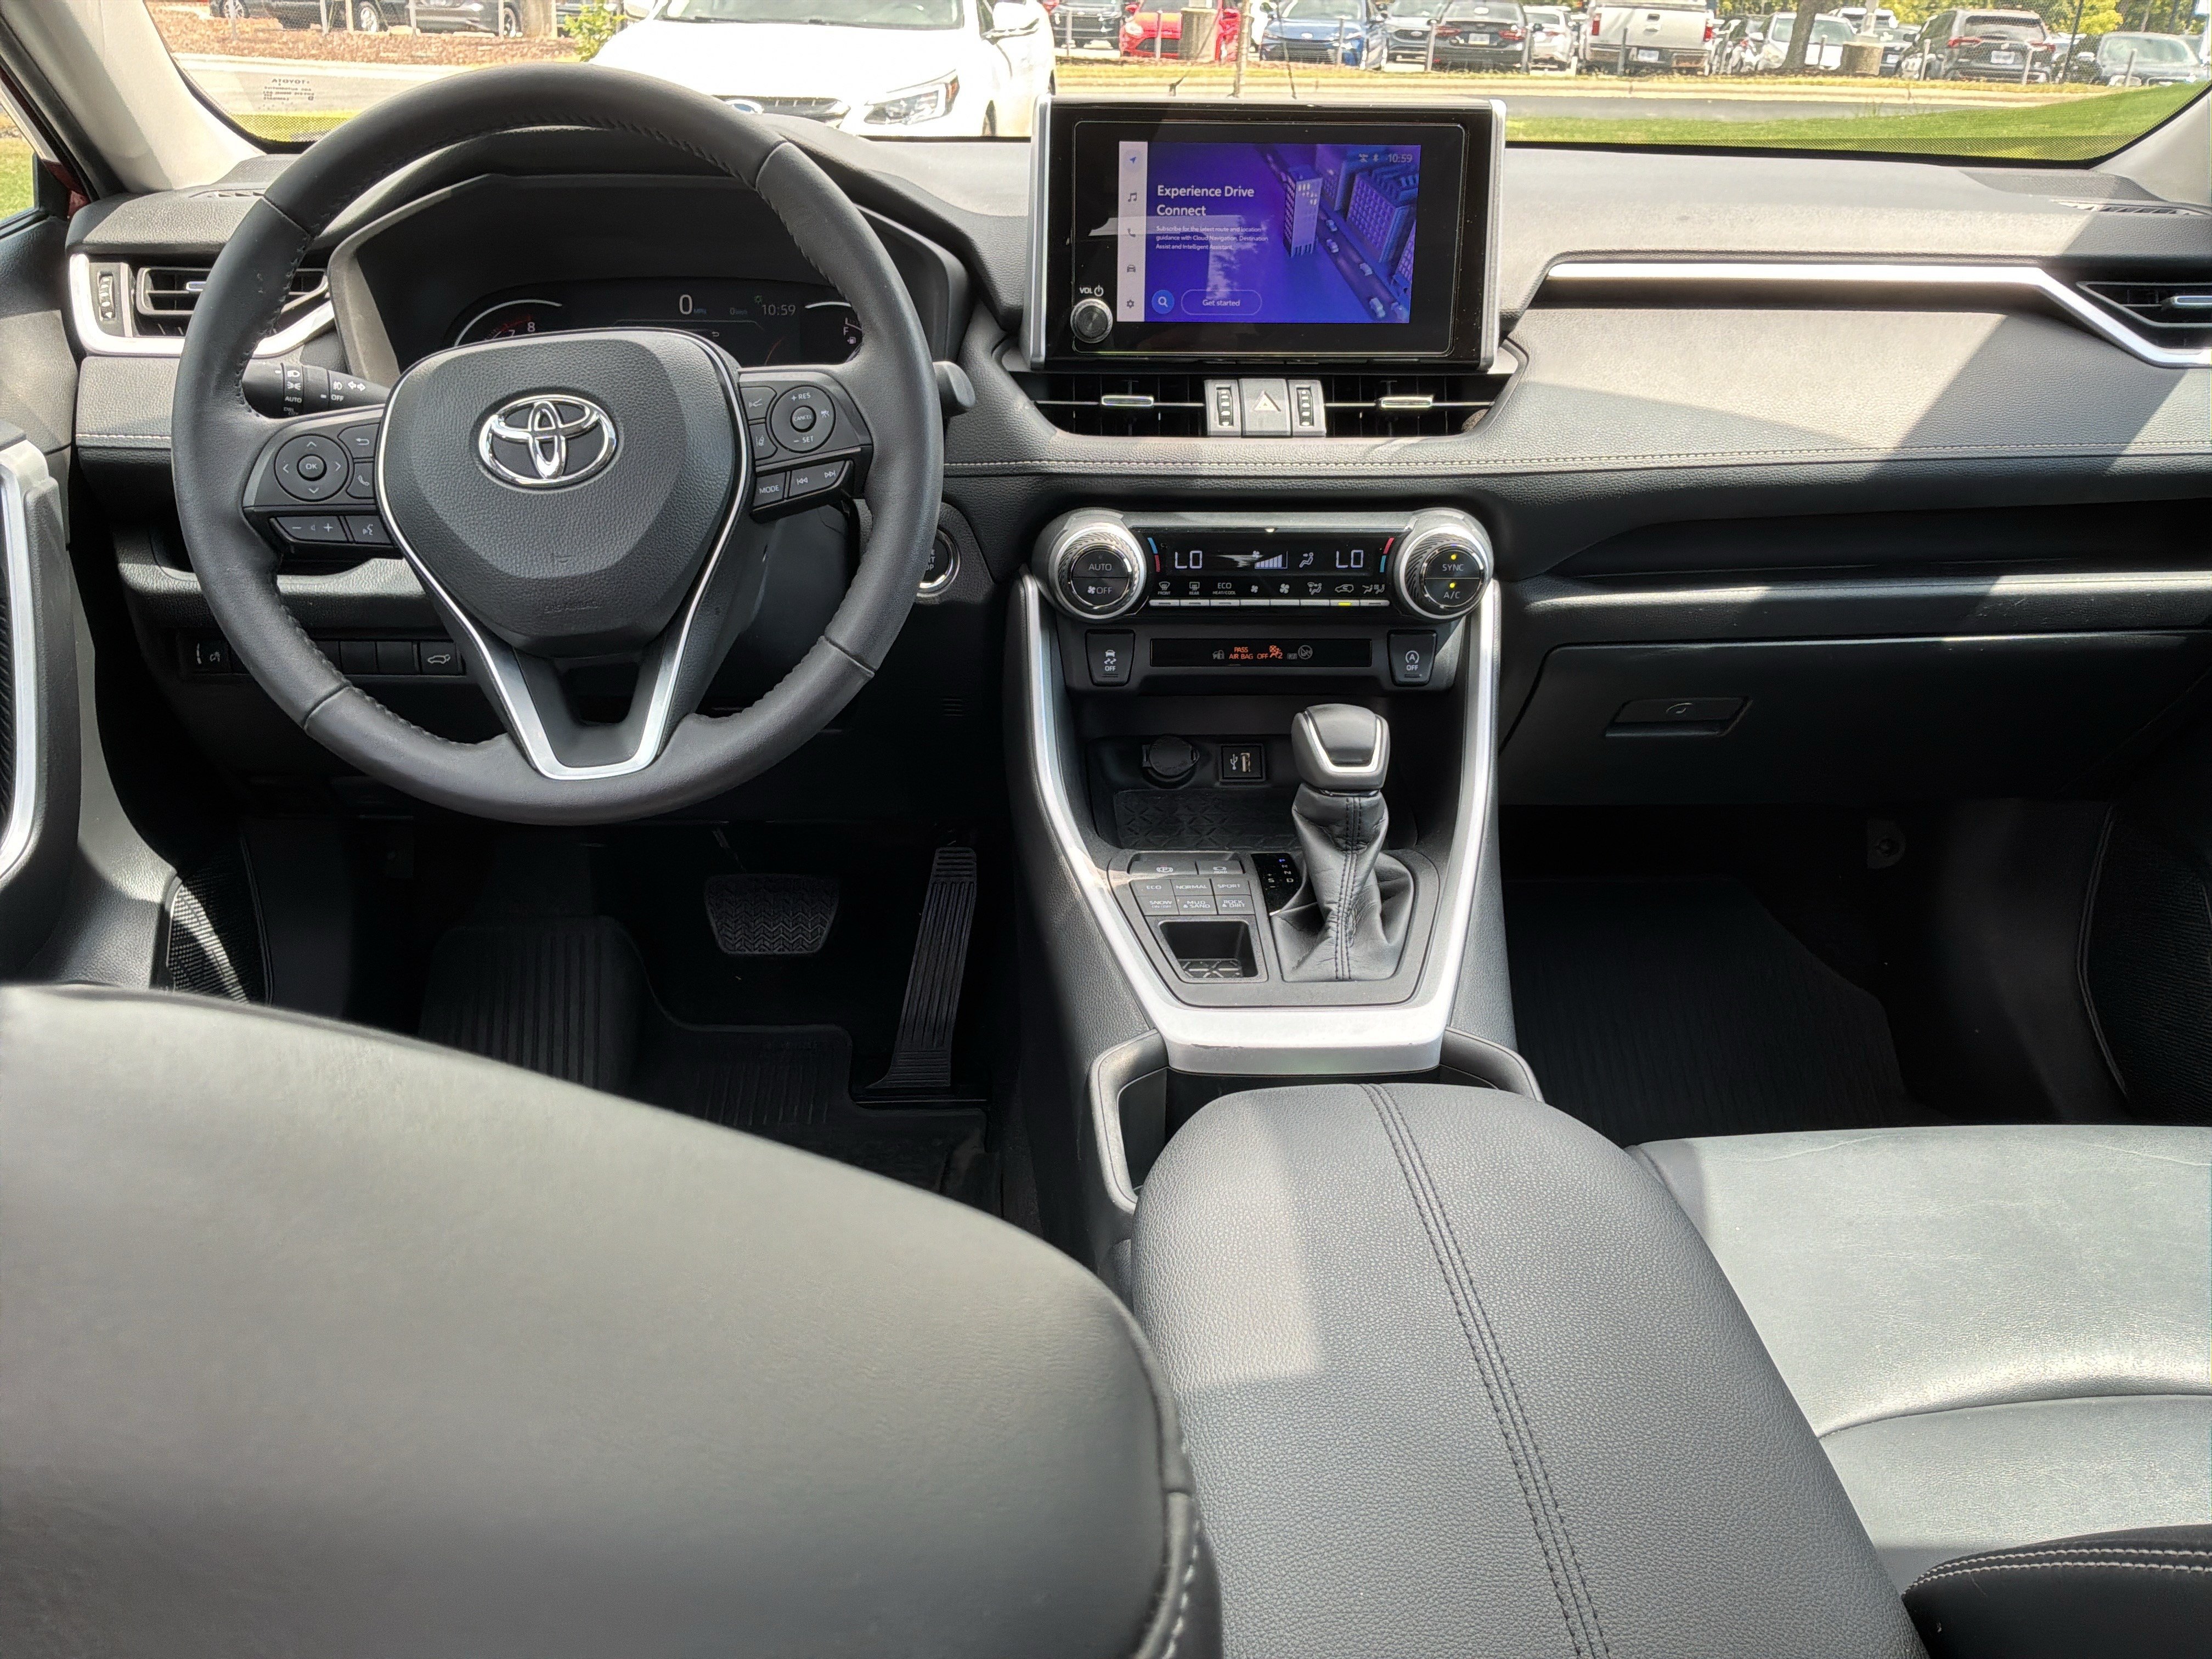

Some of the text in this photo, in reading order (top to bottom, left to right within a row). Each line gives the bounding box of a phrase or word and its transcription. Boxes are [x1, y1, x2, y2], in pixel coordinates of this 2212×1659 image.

[1388, 154, 1413, 163] 10:59
[1157, 185, 1255, 199] Experience Drive
[1156, 204, 1207, 216] Connect
[1079, 286, 1093, 295] VOL
[679, 294, 693, 315] 0
[761, 303, 796, 316] 10:59
[527, 321, 536, 332] 8
[843, 326, 849, 336] F
[284, 396, 302, 404] AUTO
[331, 394, 345, 402] OFF
[759, 484, 780, 494] MODE
[1175, 550, 1203, 569] LO
[1335, 550, 1364, 568] LO
[1088, 563, 1112, 571] AUTO
[1442, 563, 1464, 572] SYNC
[1096, 586, 1113, 595] OFF
[1443, 591, 1461, 599] A/C
